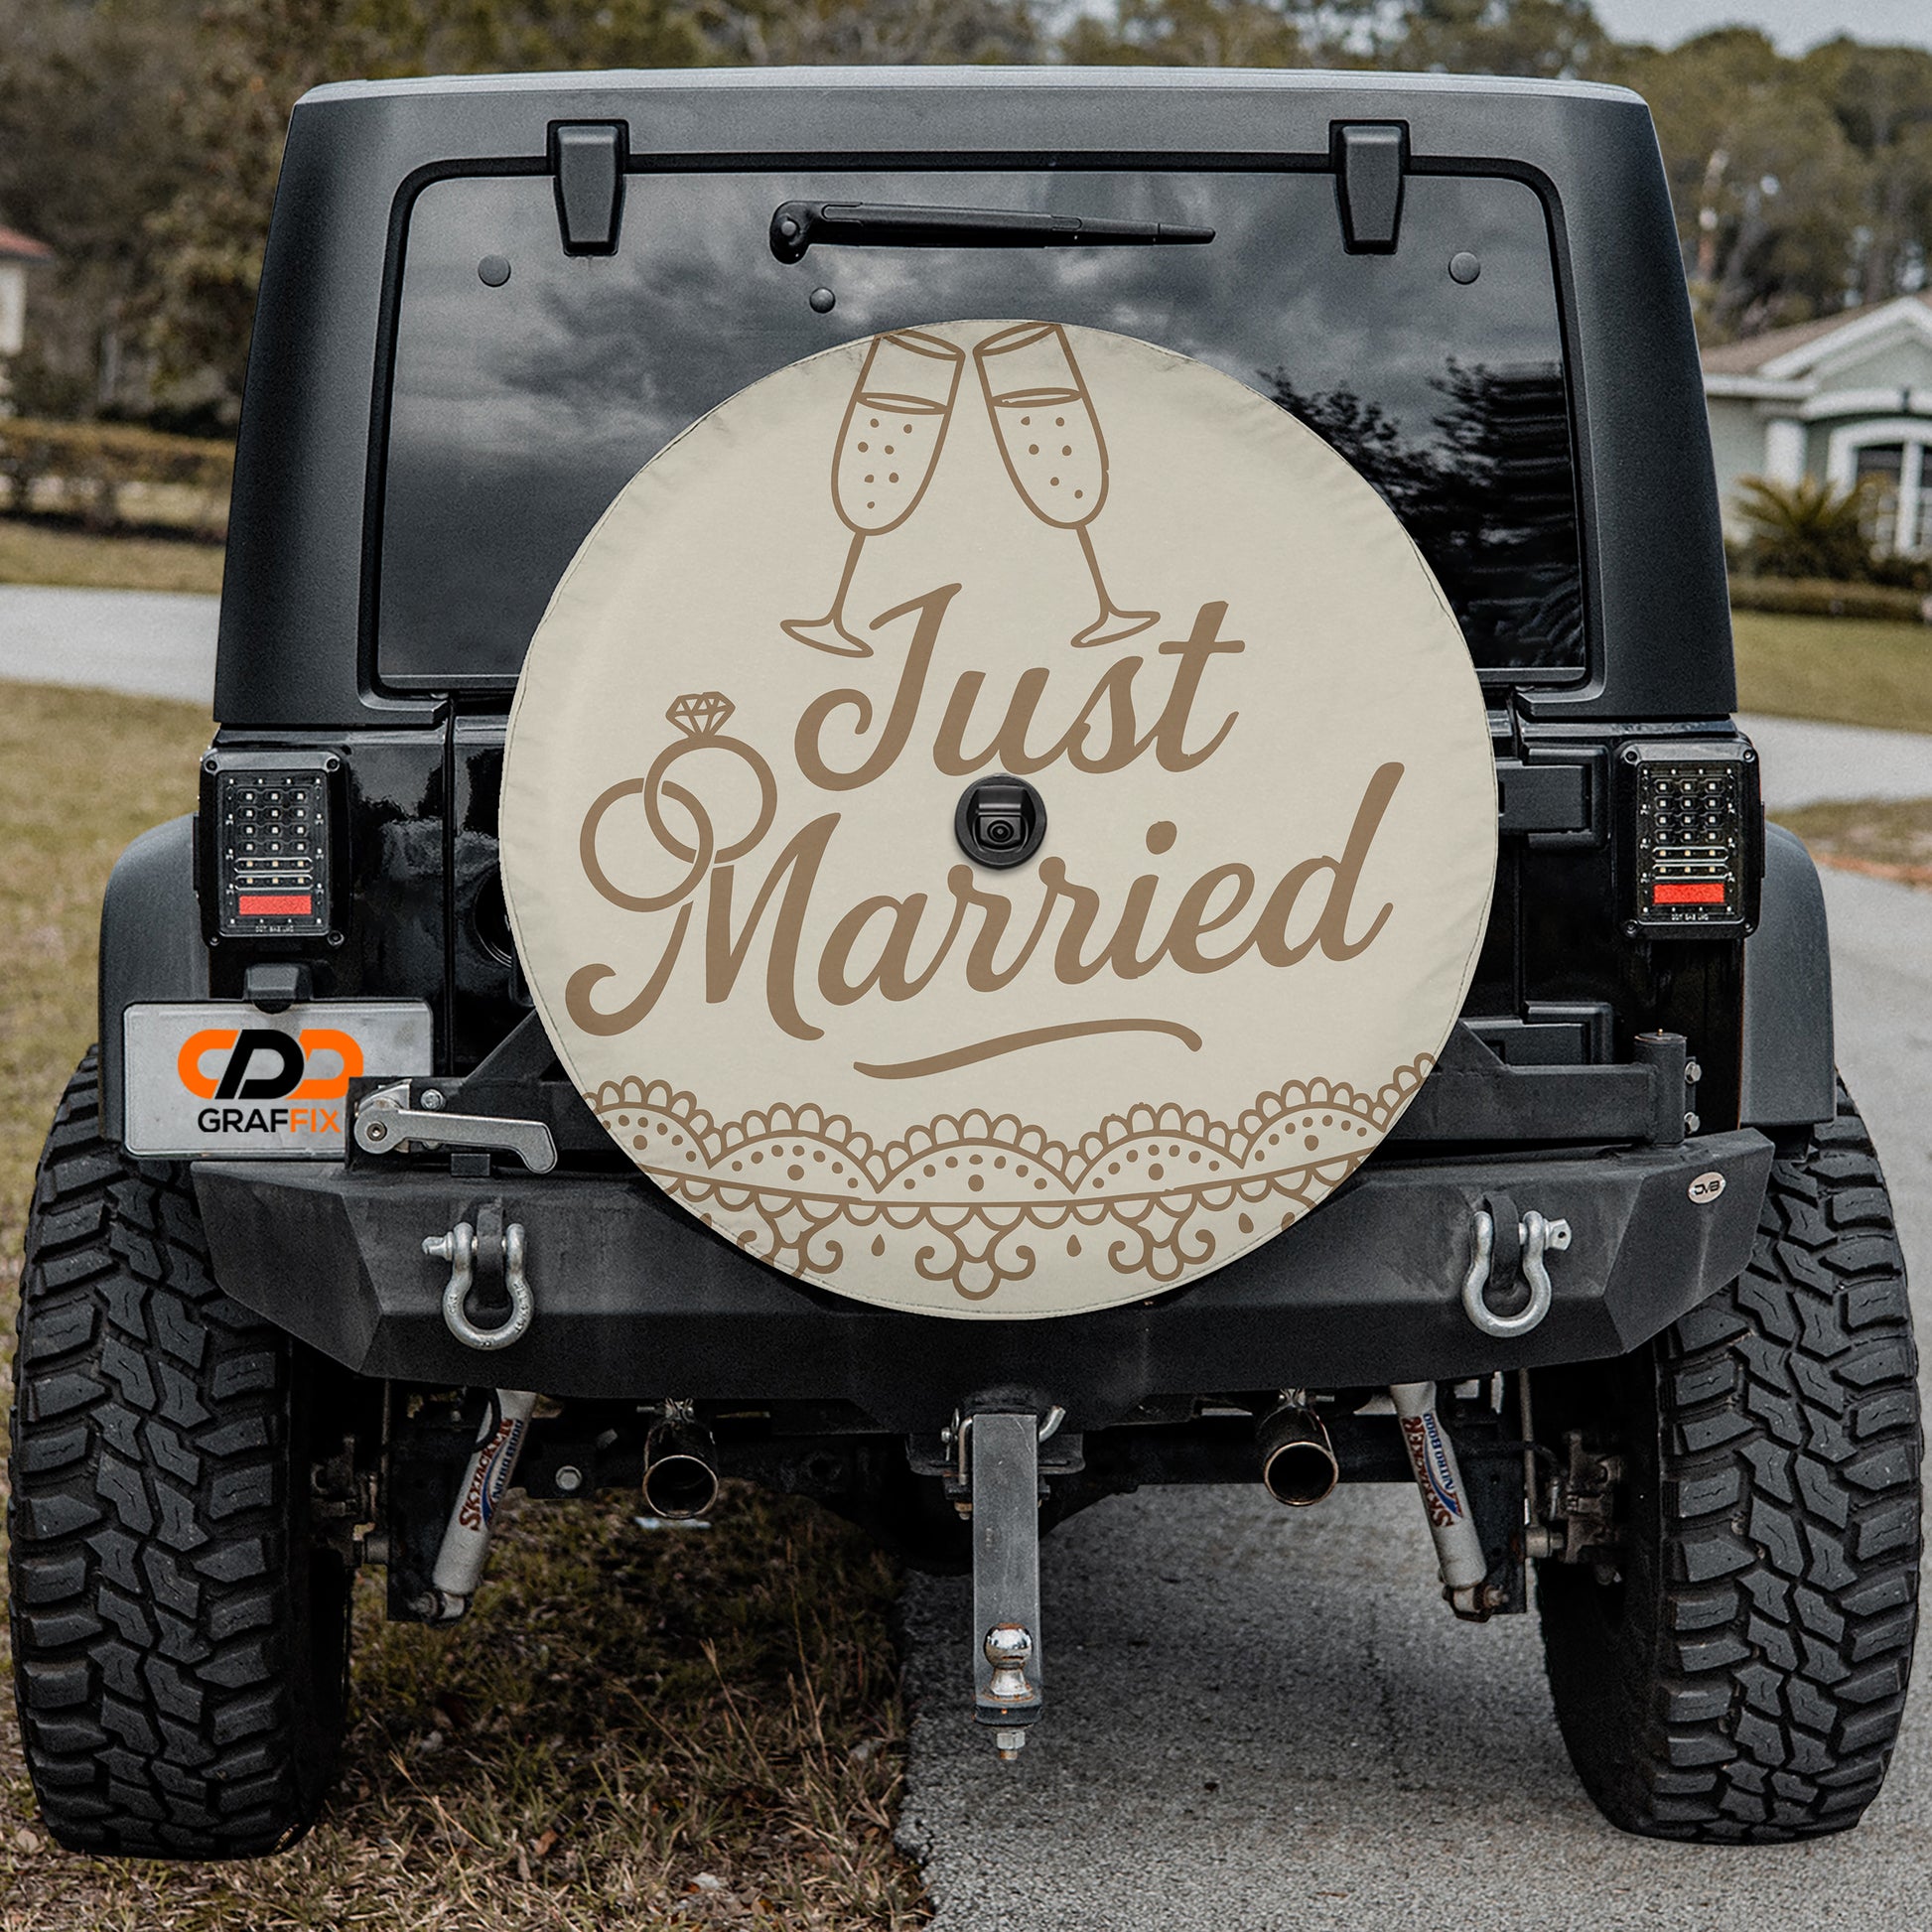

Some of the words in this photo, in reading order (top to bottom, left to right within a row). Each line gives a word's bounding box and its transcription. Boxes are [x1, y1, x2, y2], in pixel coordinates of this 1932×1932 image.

[794, 583, 1245, 791] Just
[565, 761, 1404, 1040] Married
[198, 1108, 341, 1133] GRAFFIX
[1423, 1413, 1442, 1449] 8000
[1401, 1416, 1454, 1527] SKYJACKER
[1435, 1451, 1455, 1490] NITRO
